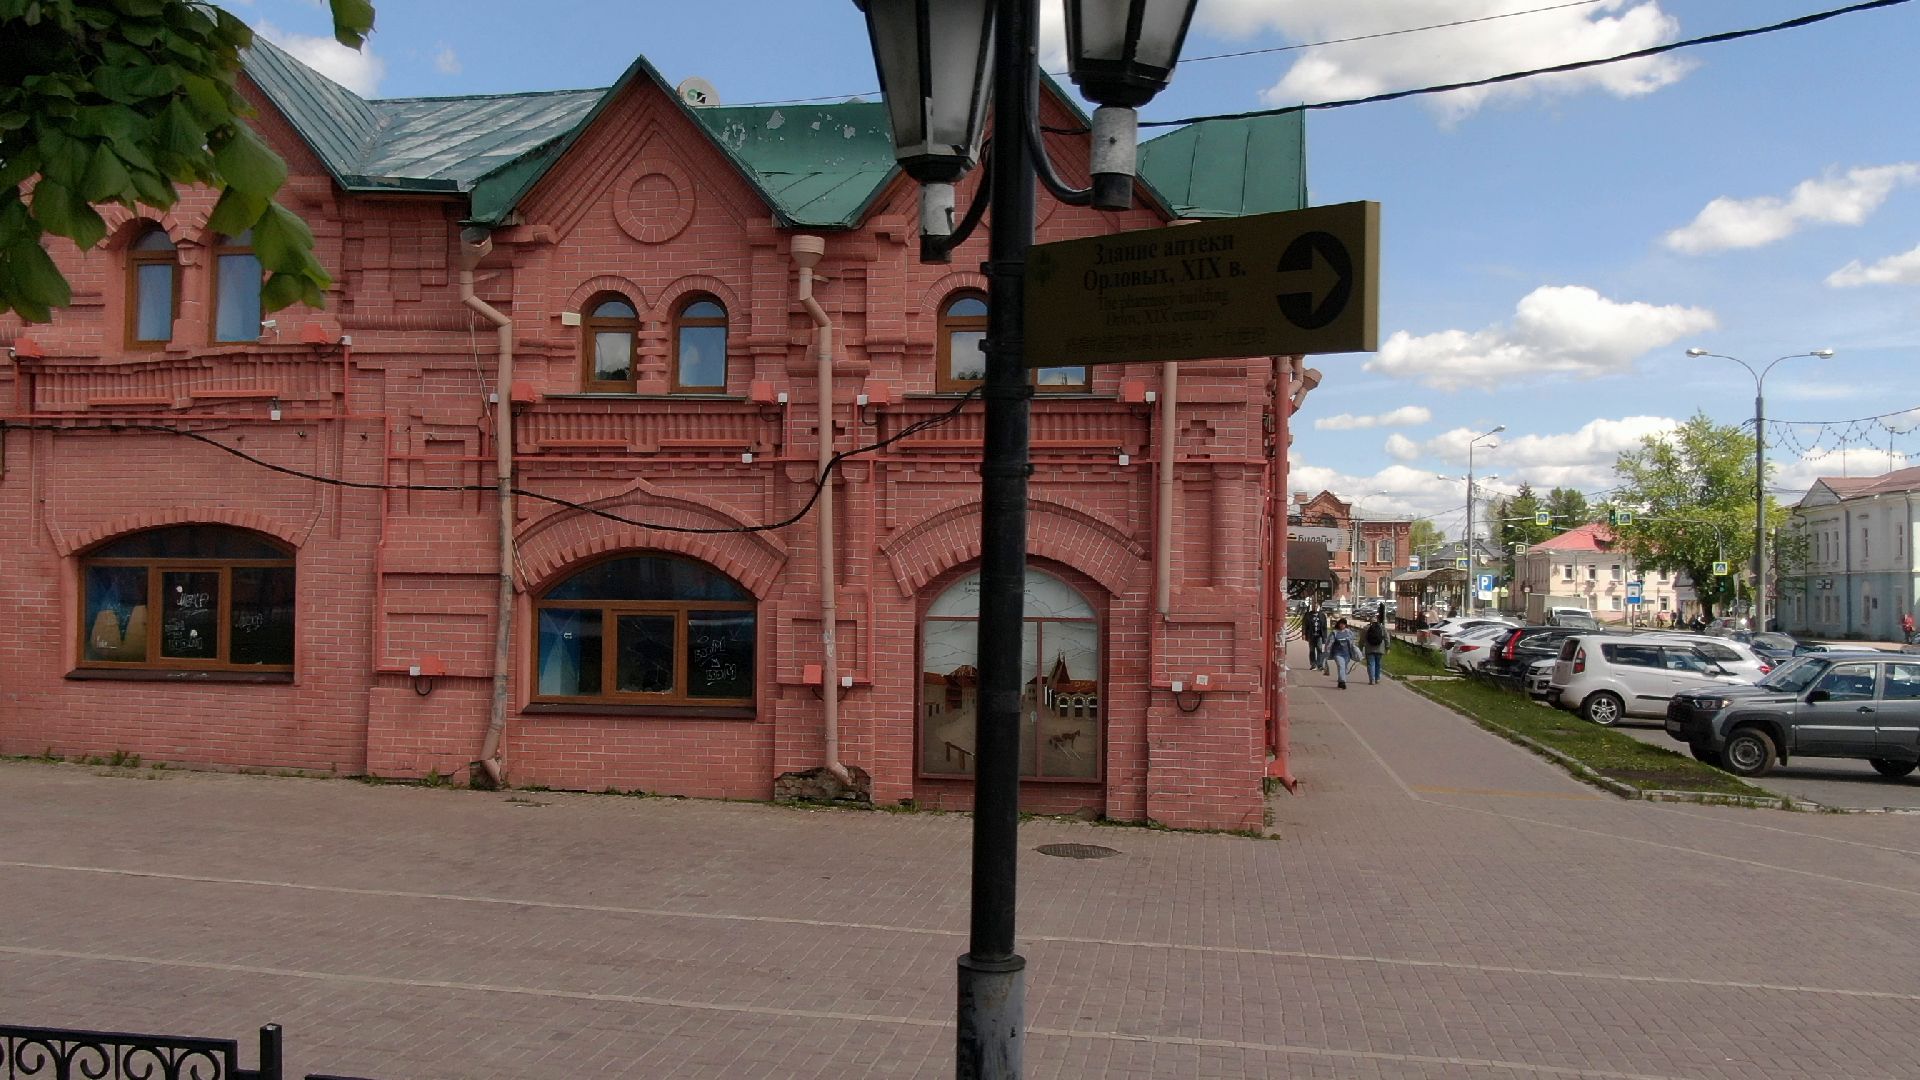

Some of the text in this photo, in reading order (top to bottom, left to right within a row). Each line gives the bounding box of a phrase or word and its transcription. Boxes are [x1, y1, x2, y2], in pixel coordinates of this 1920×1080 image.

[1095, 234, 1234, 265] Здание аптеки
[1084, 256, 1247, 295] Орловых, XIX в.
[1178, 289, 1229, 308] building
[1298, 534, 1333, 545] билайн
[1482, 577, 1489, 589] P
